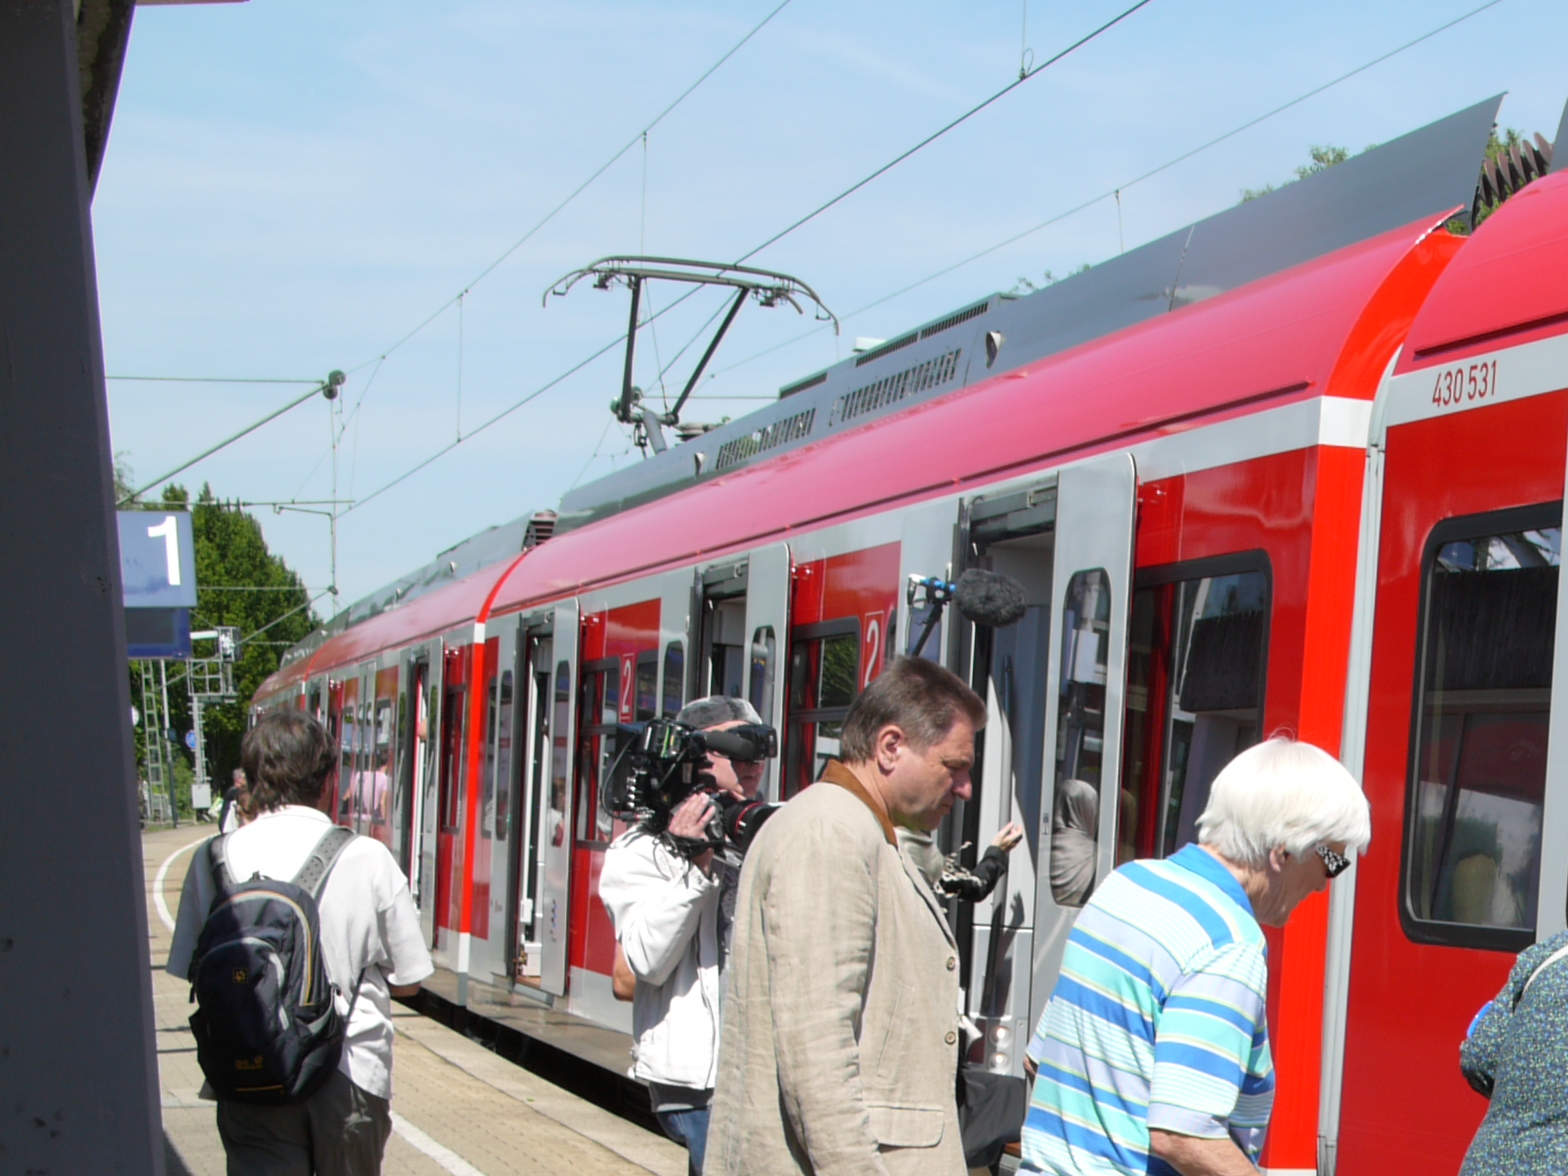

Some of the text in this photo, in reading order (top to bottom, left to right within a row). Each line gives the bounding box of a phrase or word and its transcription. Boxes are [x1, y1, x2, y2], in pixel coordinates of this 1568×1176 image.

[1432, 359, 1497, 408] 430 531
[147, 515, 181, 586] 1
[864, 619, 880, 688] 2
[622, 659, 632, 713] 2
